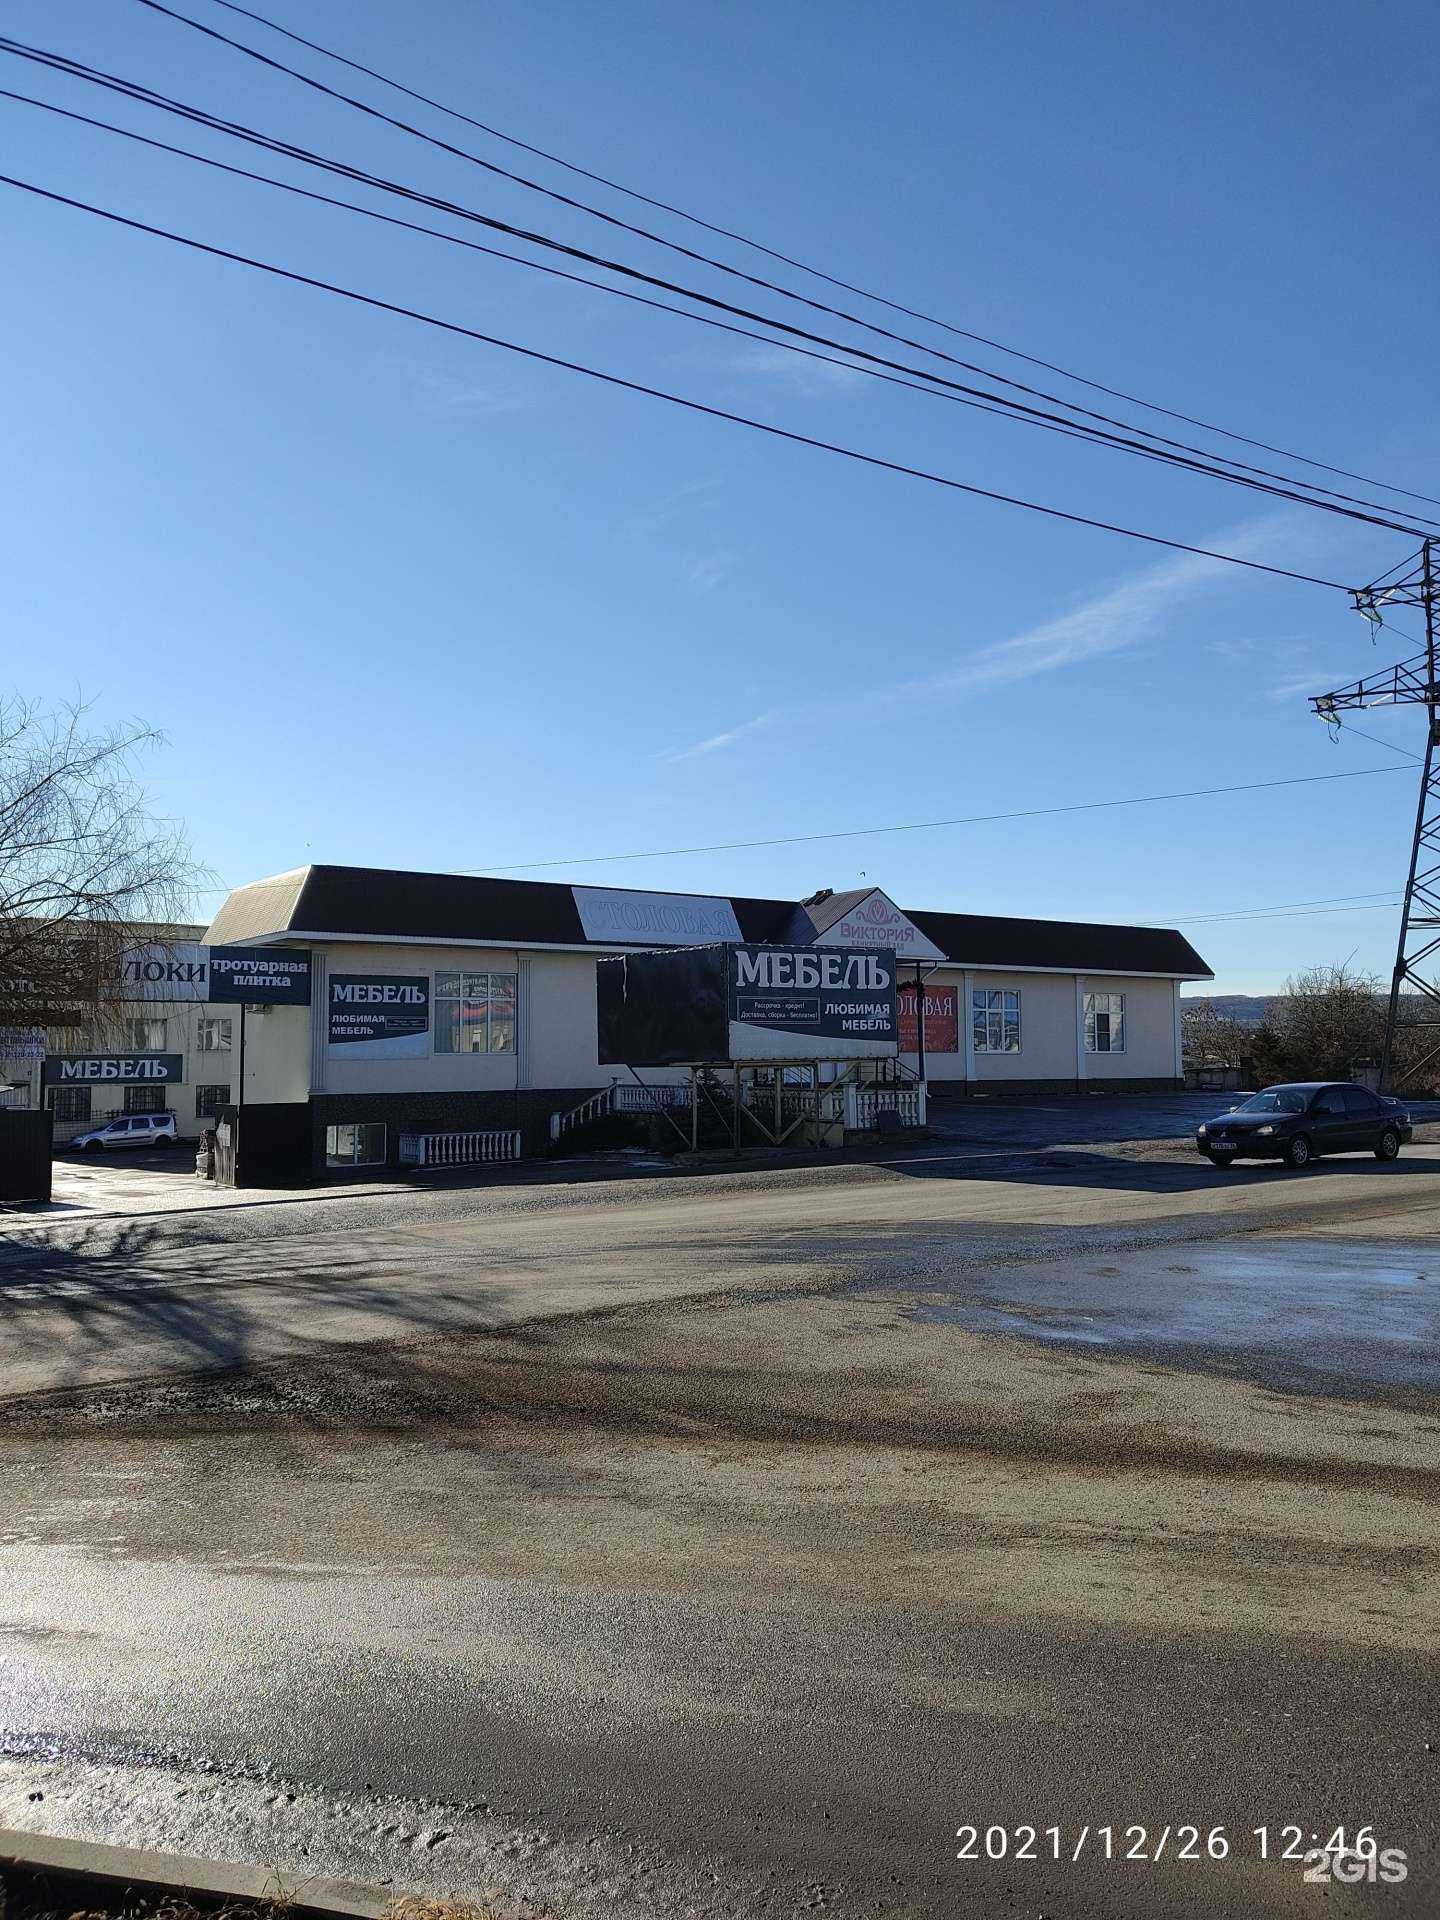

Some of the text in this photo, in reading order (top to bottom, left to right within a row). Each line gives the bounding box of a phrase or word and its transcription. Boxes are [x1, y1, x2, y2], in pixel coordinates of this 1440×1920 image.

[840, 923, 915, 942] ВИКТОРИЯ
[101, 961, 207, 983] ЛОКИ
[211, 960, 308, 974] тротуарная
[735, 951, 890, 990] МЕБЕЛЬ
[233, 976, 292, 987] плитка
[332, 984, 426, 1003] МЕБЕЛЬ
[825, 1003, 890, 1015] ЛЮБИМАЯ
[332, 1015, 385, 1023] ЛЮБИМАЯ
[842, 1019, 891, 1031] МЕБЕЛЬ
[332, 1026, 374, 1035] МЕБЕЛЬ
[60, 1059, 168, 1080] МЕБЕЛЬ
